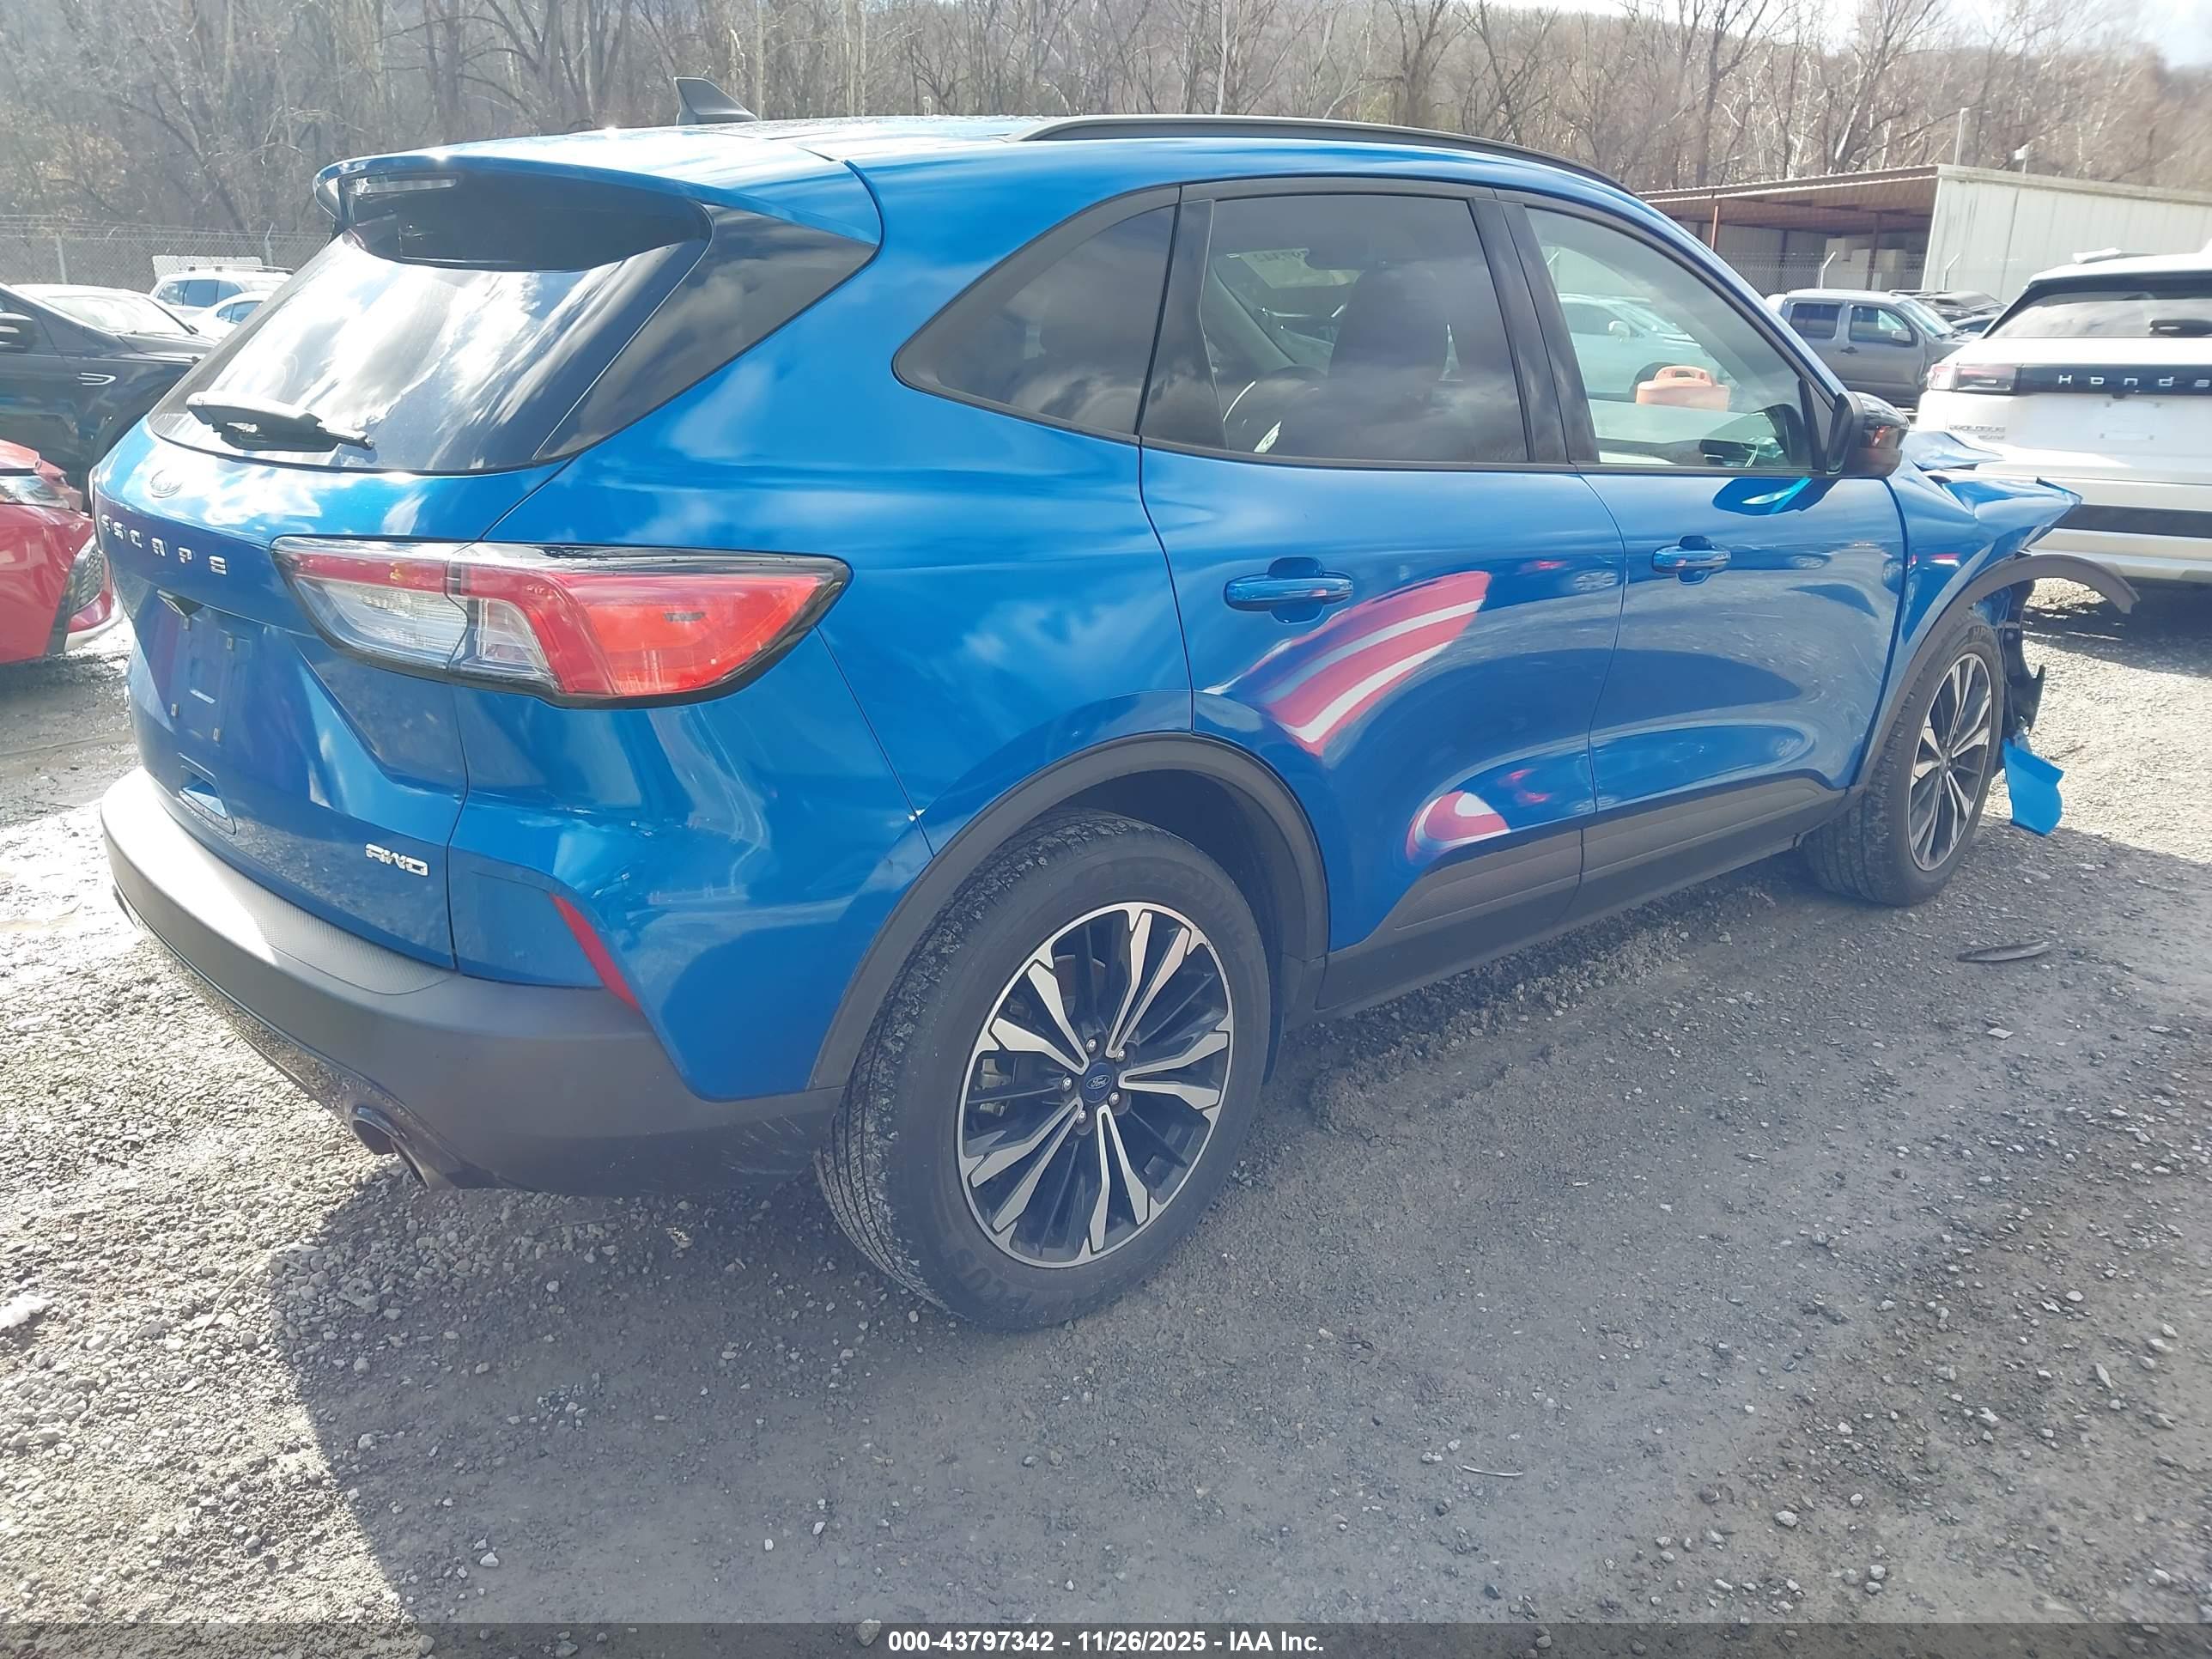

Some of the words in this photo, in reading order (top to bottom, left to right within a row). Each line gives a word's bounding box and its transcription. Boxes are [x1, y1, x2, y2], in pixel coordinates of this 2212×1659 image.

[2057, 374, 2211, 388] Honda
[100, 514, 228, 575] ESCAPE
[364, 842, 429, 877] AWD
